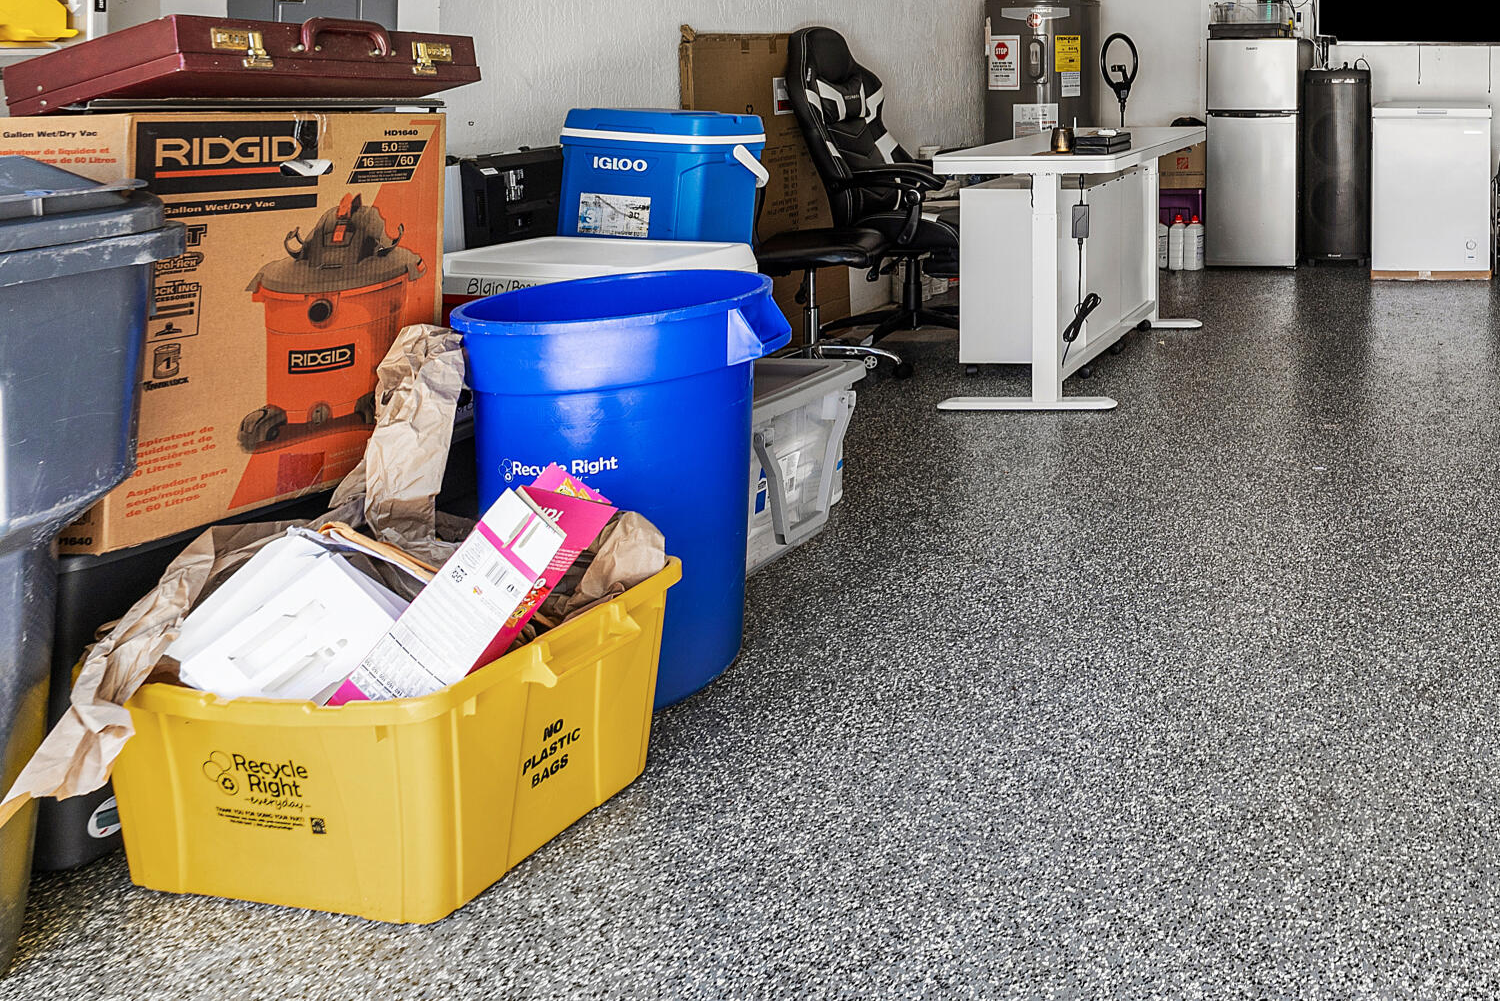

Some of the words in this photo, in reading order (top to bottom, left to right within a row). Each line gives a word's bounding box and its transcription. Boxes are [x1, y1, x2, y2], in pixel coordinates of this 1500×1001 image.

[995, 47, 1007, 55] STOP
[37, 130, 76, 139] Wet/Dry
[155, 135, 303, 167] RIDGID
[381, 142, 398, 152] 5.0
[362, 157, 374, 167] 16
[400, 155, 414, 165] 60
[593, 156, 648, 172] IGLOO
[205, 202, 253, 212] Wet/Dry
[255, 200, 276, 208] Vac
[156, 258, 197, 271] ual-flex
[291, 347, 352, 367] RIDGID
[137, 442, 179, 459] quides
[182, 438, 195, 446] et
[198, 434, 212, 443] de
[138, 429, 196, 448] spirateur
[199, 425, 214, 433] de
[136, 447, 198, 467] oussières
[201, 442, 216, 451] de
[571, 456, 619, 475] Right
[146, 460, 182, 474] Litres
[125, 474, 198, 499] Aspiradora
[200, 466, 228, 481] para
[125, 508, 142, 518] de
[145, 503, 161, 513] 60
[164, 493, 201, 508] Litres
[543, 718, 564, 742] NO
[522, 727, 581, 776] PLASTIC
[231, 753, 308, 779] Recycle
[531, 753, 569, 789] BAGS
[247, 773, 303, 798] Right
